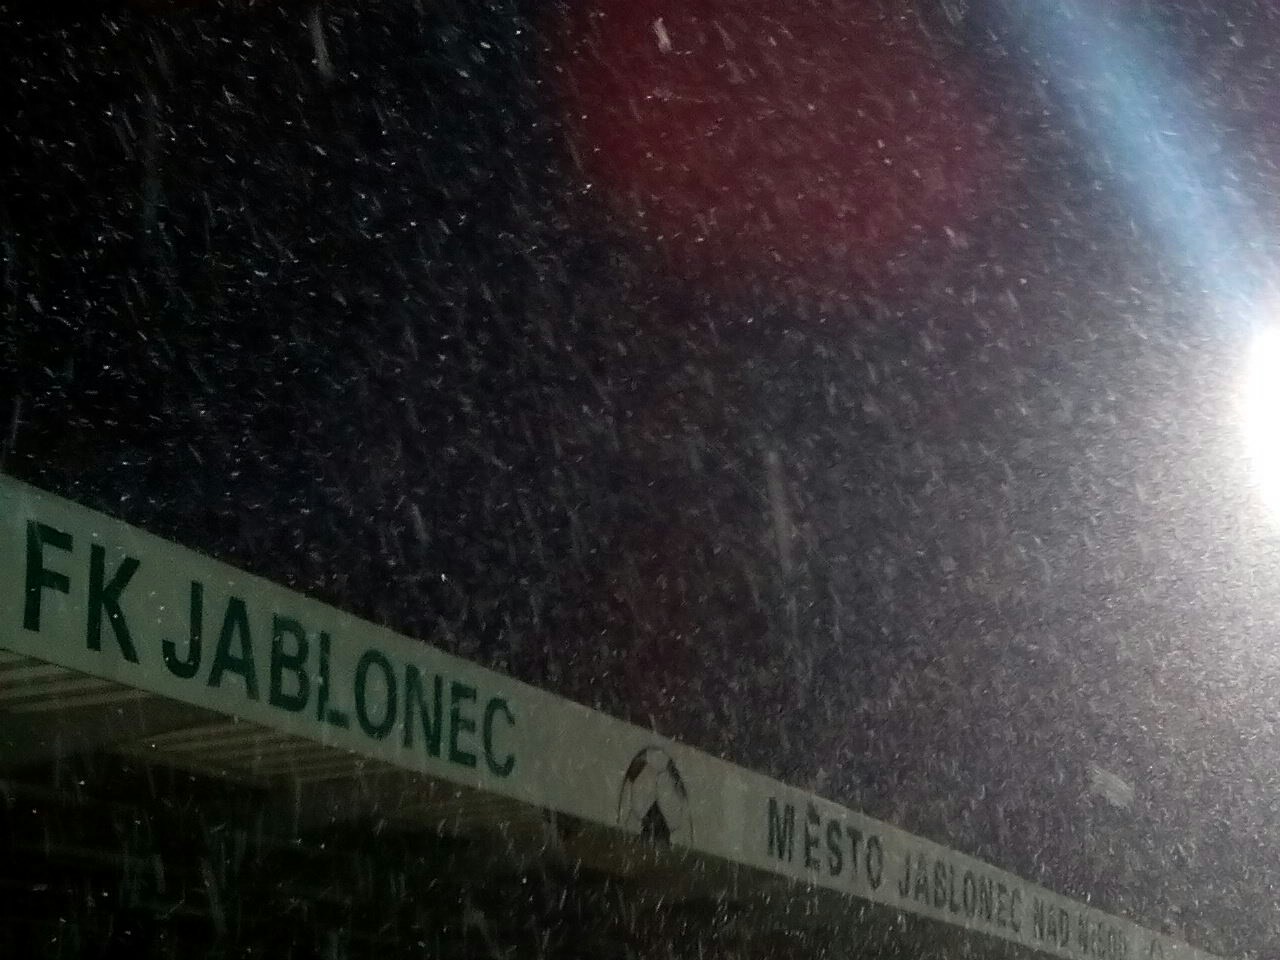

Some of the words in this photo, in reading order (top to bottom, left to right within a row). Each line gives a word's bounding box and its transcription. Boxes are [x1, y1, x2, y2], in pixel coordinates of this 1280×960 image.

[23, 520, 141, 663] FK
[162, 580, 516, 777] JABLONEC
[767, 796, 884, 890] MĚSTO
[898, 853, 1023, 932] JABLONEC
[1033, 896, 1070, 949] NAD
